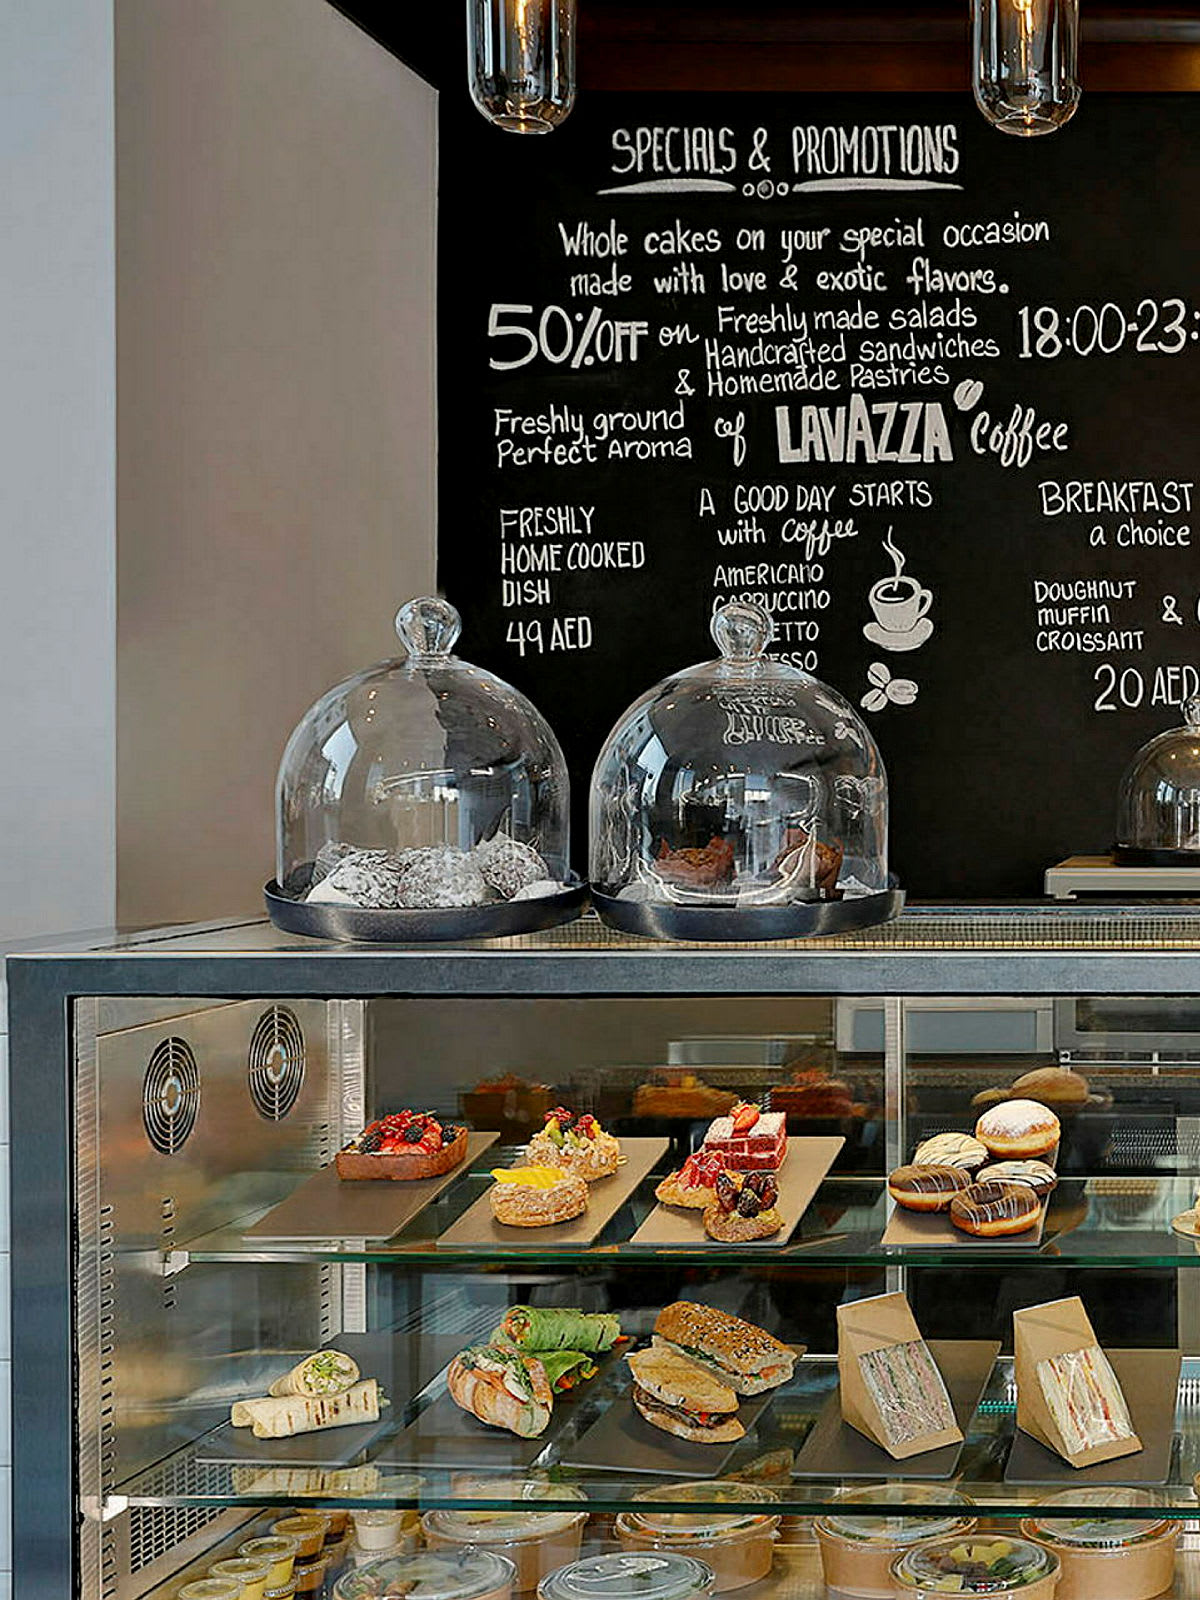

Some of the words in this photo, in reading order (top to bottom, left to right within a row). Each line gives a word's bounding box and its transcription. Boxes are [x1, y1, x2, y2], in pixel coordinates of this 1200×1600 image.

[612, 127, 736, 174] SPECIALS
[749, 127, 770, 172] &
[793, 125, 959, 175] PROMOTIONS
[559, 219, 628, 257] Whole
[643, 217, 722, 256] cakes
[737, 229, 764, 250] on
[782, 228, 830, 263] your
[839, 216, 926, 262] special
[944, 211, 1049, 247] occasion
[571, 259, 632, 297] made
[654, 262, 705, 294] with
[721, 263, 766, 292] love
[780, 264, 797, 290] &
[816, 262, 888, 293] exotic
[907, 257, 1009, 295] flavors.
[659, 324, 699, 346] on
[717, 306, 808, 340] Freshly
[814, 306, 880, 331] made
[889, 300, 977, 330] salads
[704, 337, 848, 372] Handcrafted
[858, 332, 1001, 363] sandwiches
[675, 369, 695, 395] &
[707, 366, 842, 398] Homemade
[851, 364, 949, 389] Pastries
[494, 404, 585, 443] Freshly
[592, 399, 686, 441] ground
[715, 412, 746, 467] of
[775, 393, 953, 463] LAVAZZA
[971, 404, 1068, 467] Coffee
[497, 435, 599, 469] Perfect
[608, 437, 692, 459] Aroma
[700, 489, 715, 516] A
[735, 485, 788, 514] GOOD
[796, 485, 836, 512] DAY
[849, 481, 932, 507] STARTS
[1038, 481, 1193, 515] BREAKFAST
[500, 506, 594, 538] FRESHLY
[718, 517, 765, 545] with
[1090, 526, 1106, 546] a
[1117, 518, 1190, 546] choice
[501, 543, 562, 574] HOME
[567, 542, 645, 570] COOKED
[503, 578, 550, 606] DISH
[1162, 596, 1183, 625] &
[506, 620, 543, 656] 49
[551, 617, 591, 650] AED
[1095, 664, 1143, 711] 20
[1151, 665, 1200, 706] AED
